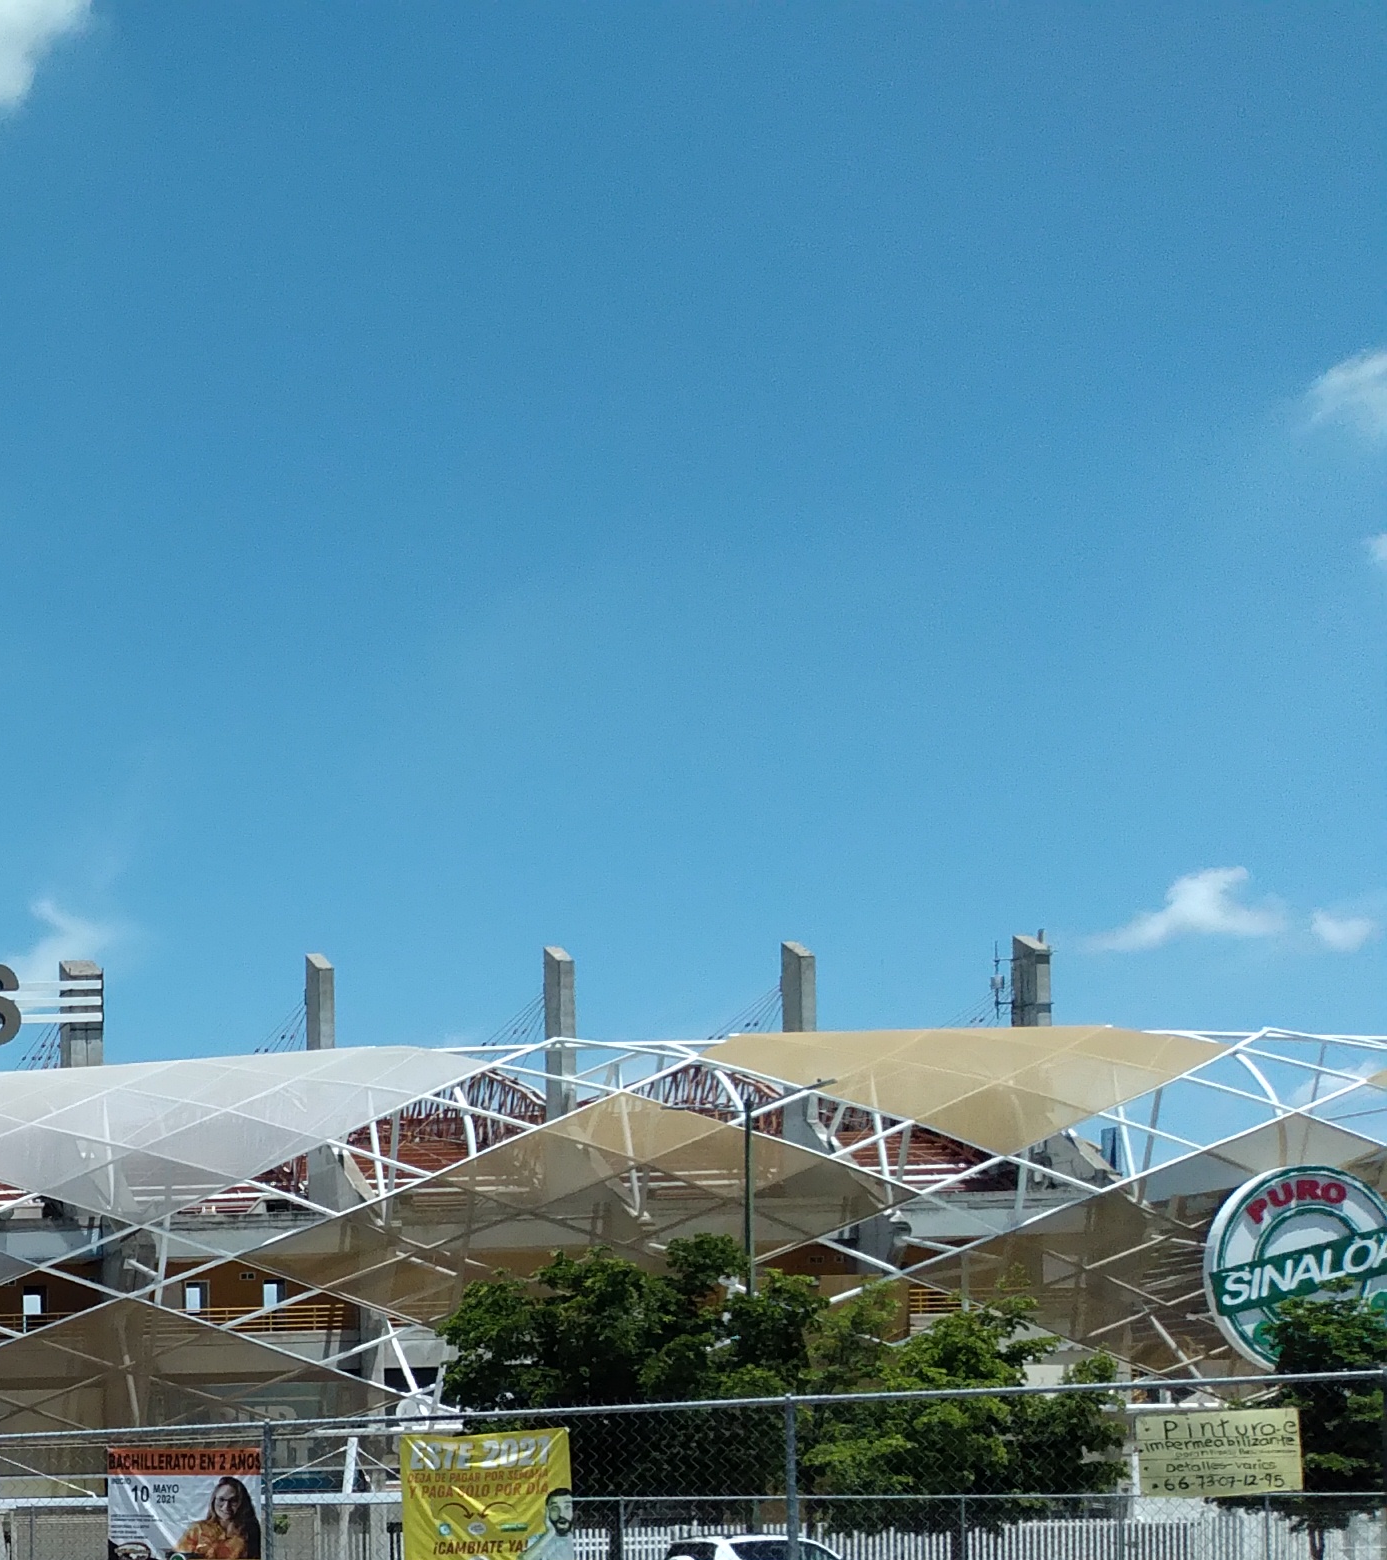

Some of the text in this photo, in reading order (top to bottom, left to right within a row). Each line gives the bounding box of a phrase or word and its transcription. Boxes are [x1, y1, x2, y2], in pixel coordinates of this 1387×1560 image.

[1246, 1179, 1348, 1225] PURO
[108, 1453, 196, 1471] BACHILLERATO
[199, 1453, 216, 1470] EN
[219, 1453, 226, 1470] 2
[229, 1450, 261, 1470] AÑOS
[410, 1436, 551, 1471] ESTE 2021
[434, 1472, 446, 1483] DE
[449, 1471, 482, 1483] PAGAR
[484, 1470, 504, 1482] POR
[131, 1485, 150, 1502] 10
[153, 1484, 179, 1494] MAYO
[409, 1486, 417, 1499] Y
[421, 1485, 454, 1499] PAGA
[494, 1483, 522, 1496] POR
[156, 1494, 176, 1504] 2021
